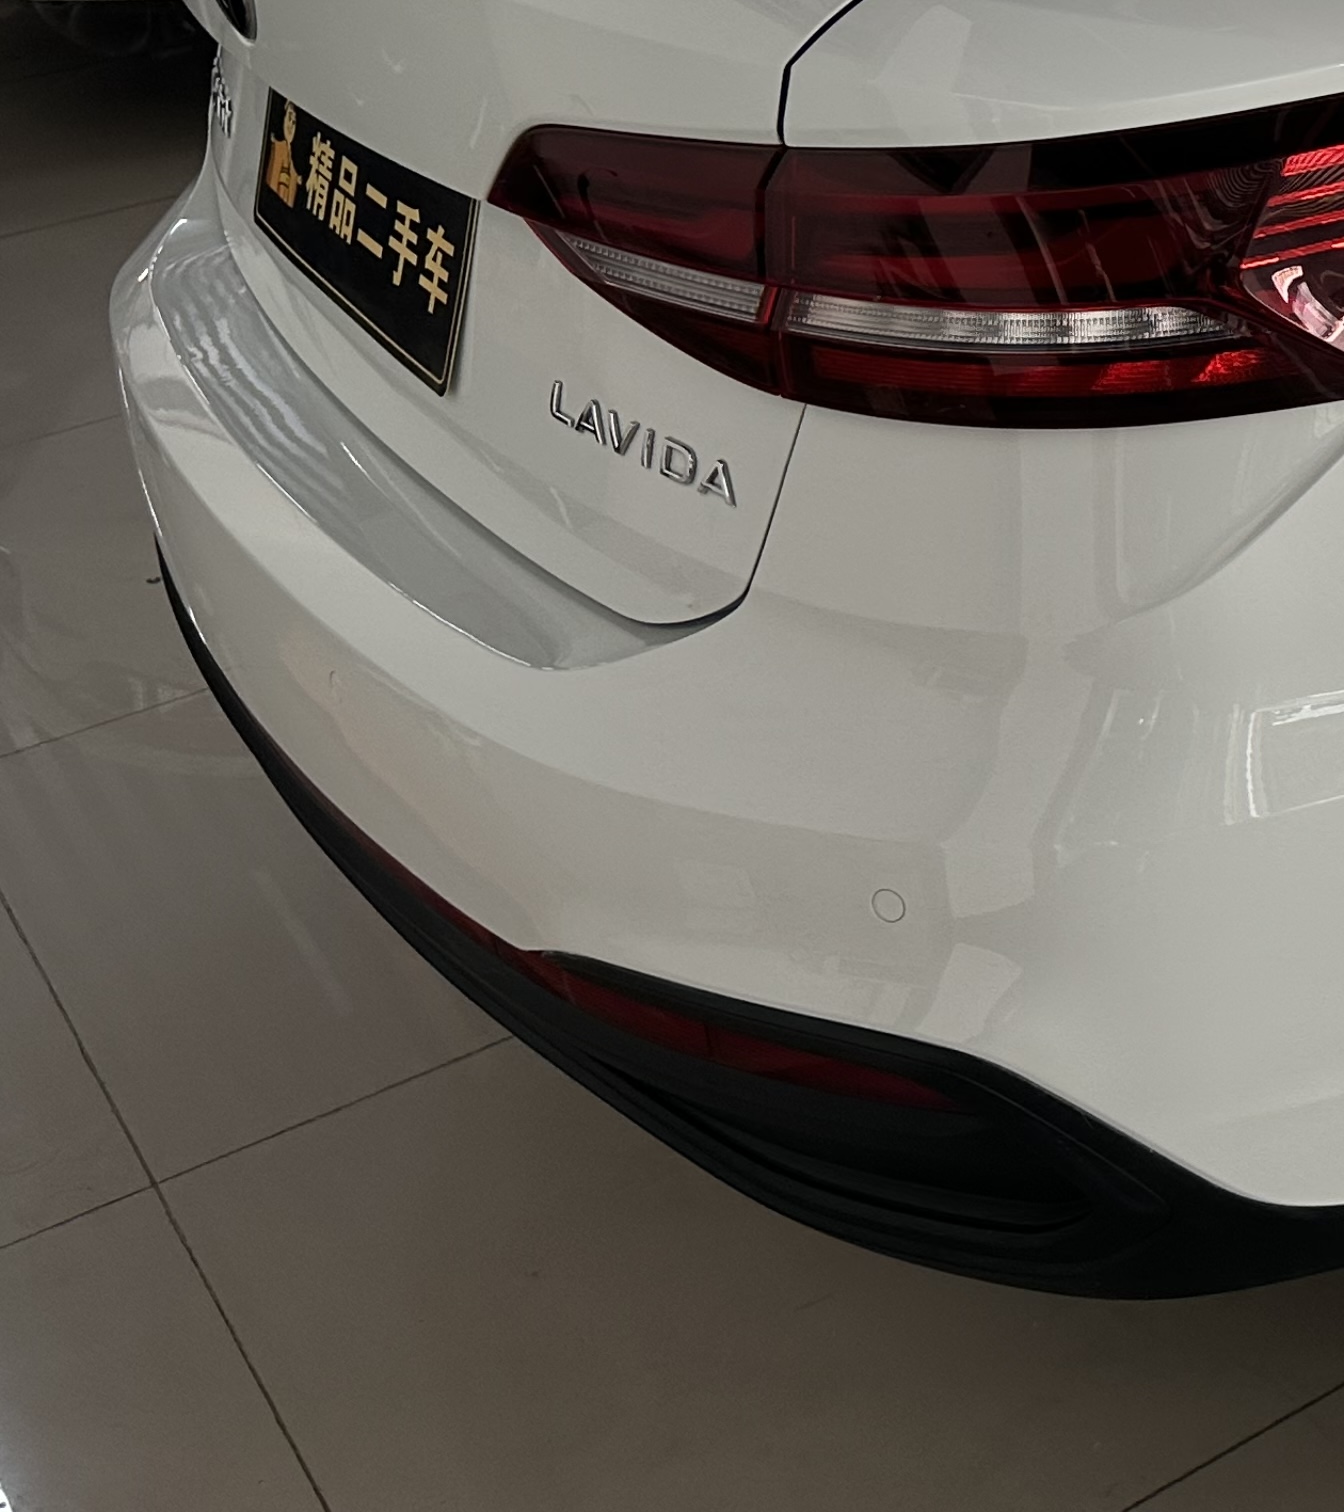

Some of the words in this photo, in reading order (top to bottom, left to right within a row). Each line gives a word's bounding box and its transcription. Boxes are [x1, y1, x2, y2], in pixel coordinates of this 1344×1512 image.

[306, 131, 455, 314] 精品二手车
[550, 380, 737, 508] LAVIDA
